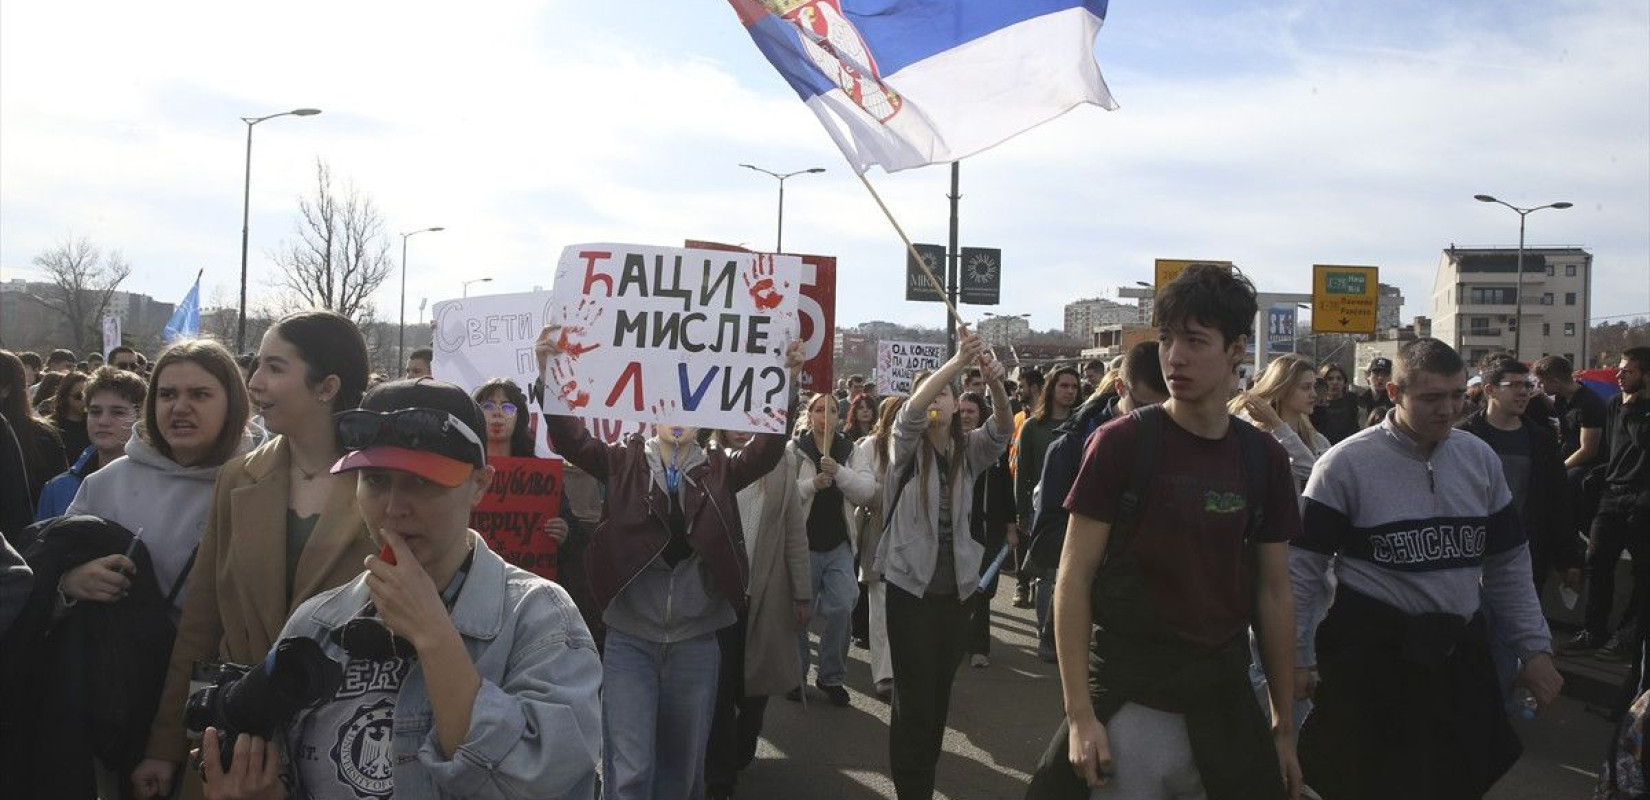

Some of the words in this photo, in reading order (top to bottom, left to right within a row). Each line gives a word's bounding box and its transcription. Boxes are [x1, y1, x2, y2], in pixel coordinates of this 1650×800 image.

[579, 251, 737, 311] ЋАЦИ
[613, 310, 782, 357] МИСЛЕ,
[1371, 526, 1486, 564] CHICAGO
